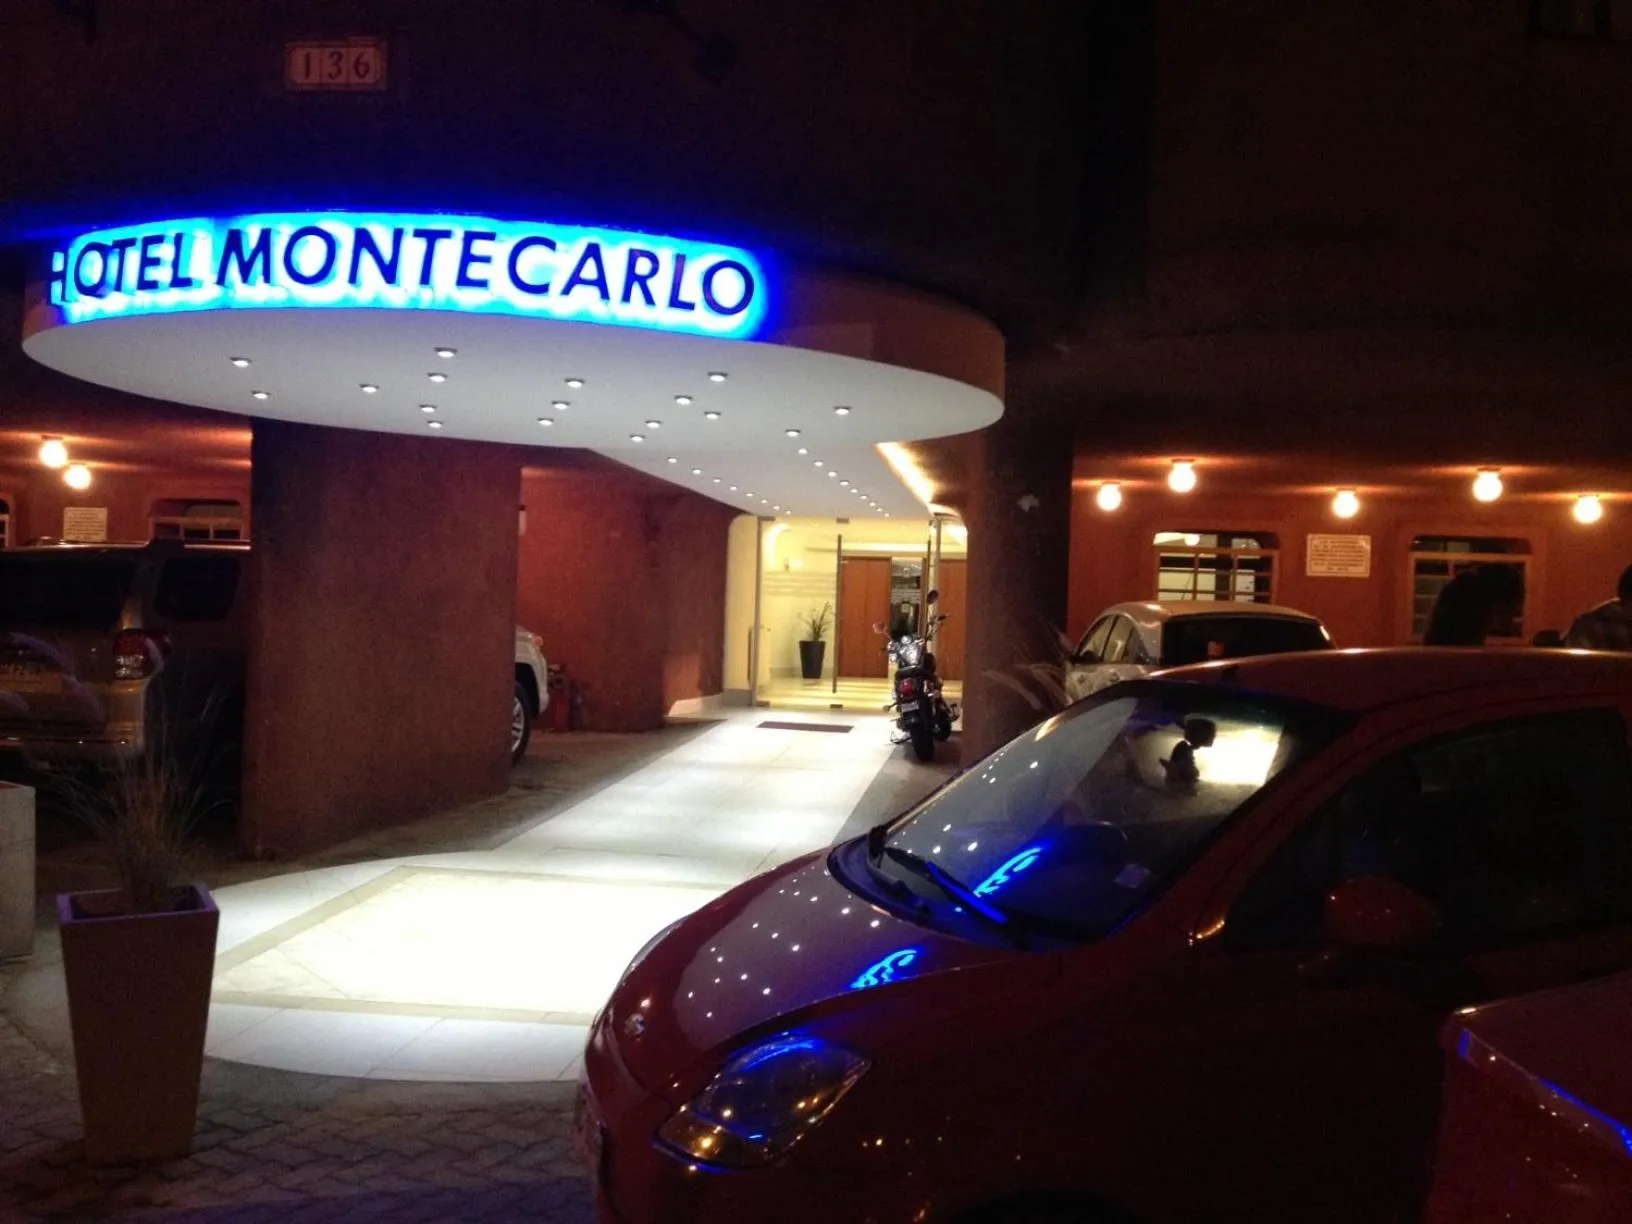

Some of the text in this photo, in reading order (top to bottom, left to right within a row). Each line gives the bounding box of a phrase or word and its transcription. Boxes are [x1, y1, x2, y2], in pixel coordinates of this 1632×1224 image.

[304, 50, 371, 81] 136
[48, 225, 754, 316] HOTEL MONTECARLO
